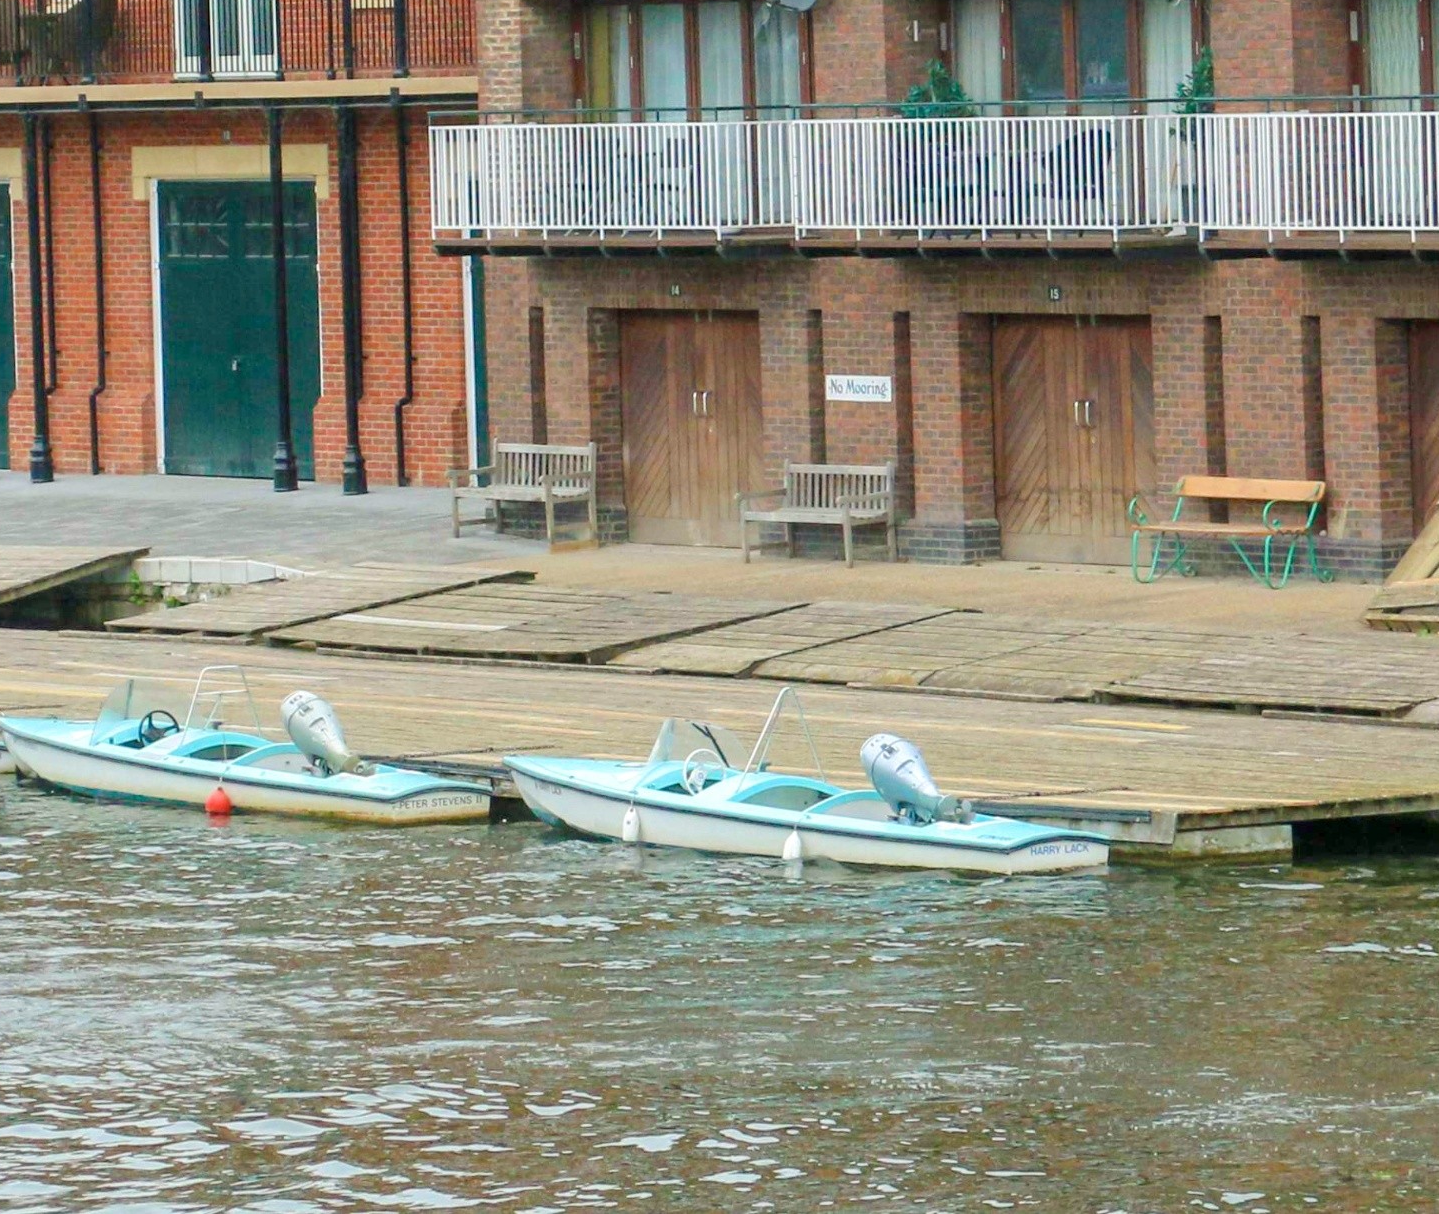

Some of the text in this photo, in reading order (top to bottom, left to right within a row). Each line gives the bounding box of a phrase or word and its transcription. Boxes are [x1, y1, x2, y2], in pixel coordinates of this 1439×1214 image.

[1050, 288, 1059, 300] 15
[830, 378, 886, 399] No Mooring
[399, 798, 428, 809] PETER
[431, 795, 473, 806] STEVENS
[1030, 843, 1090, 857] HARRY LACK
